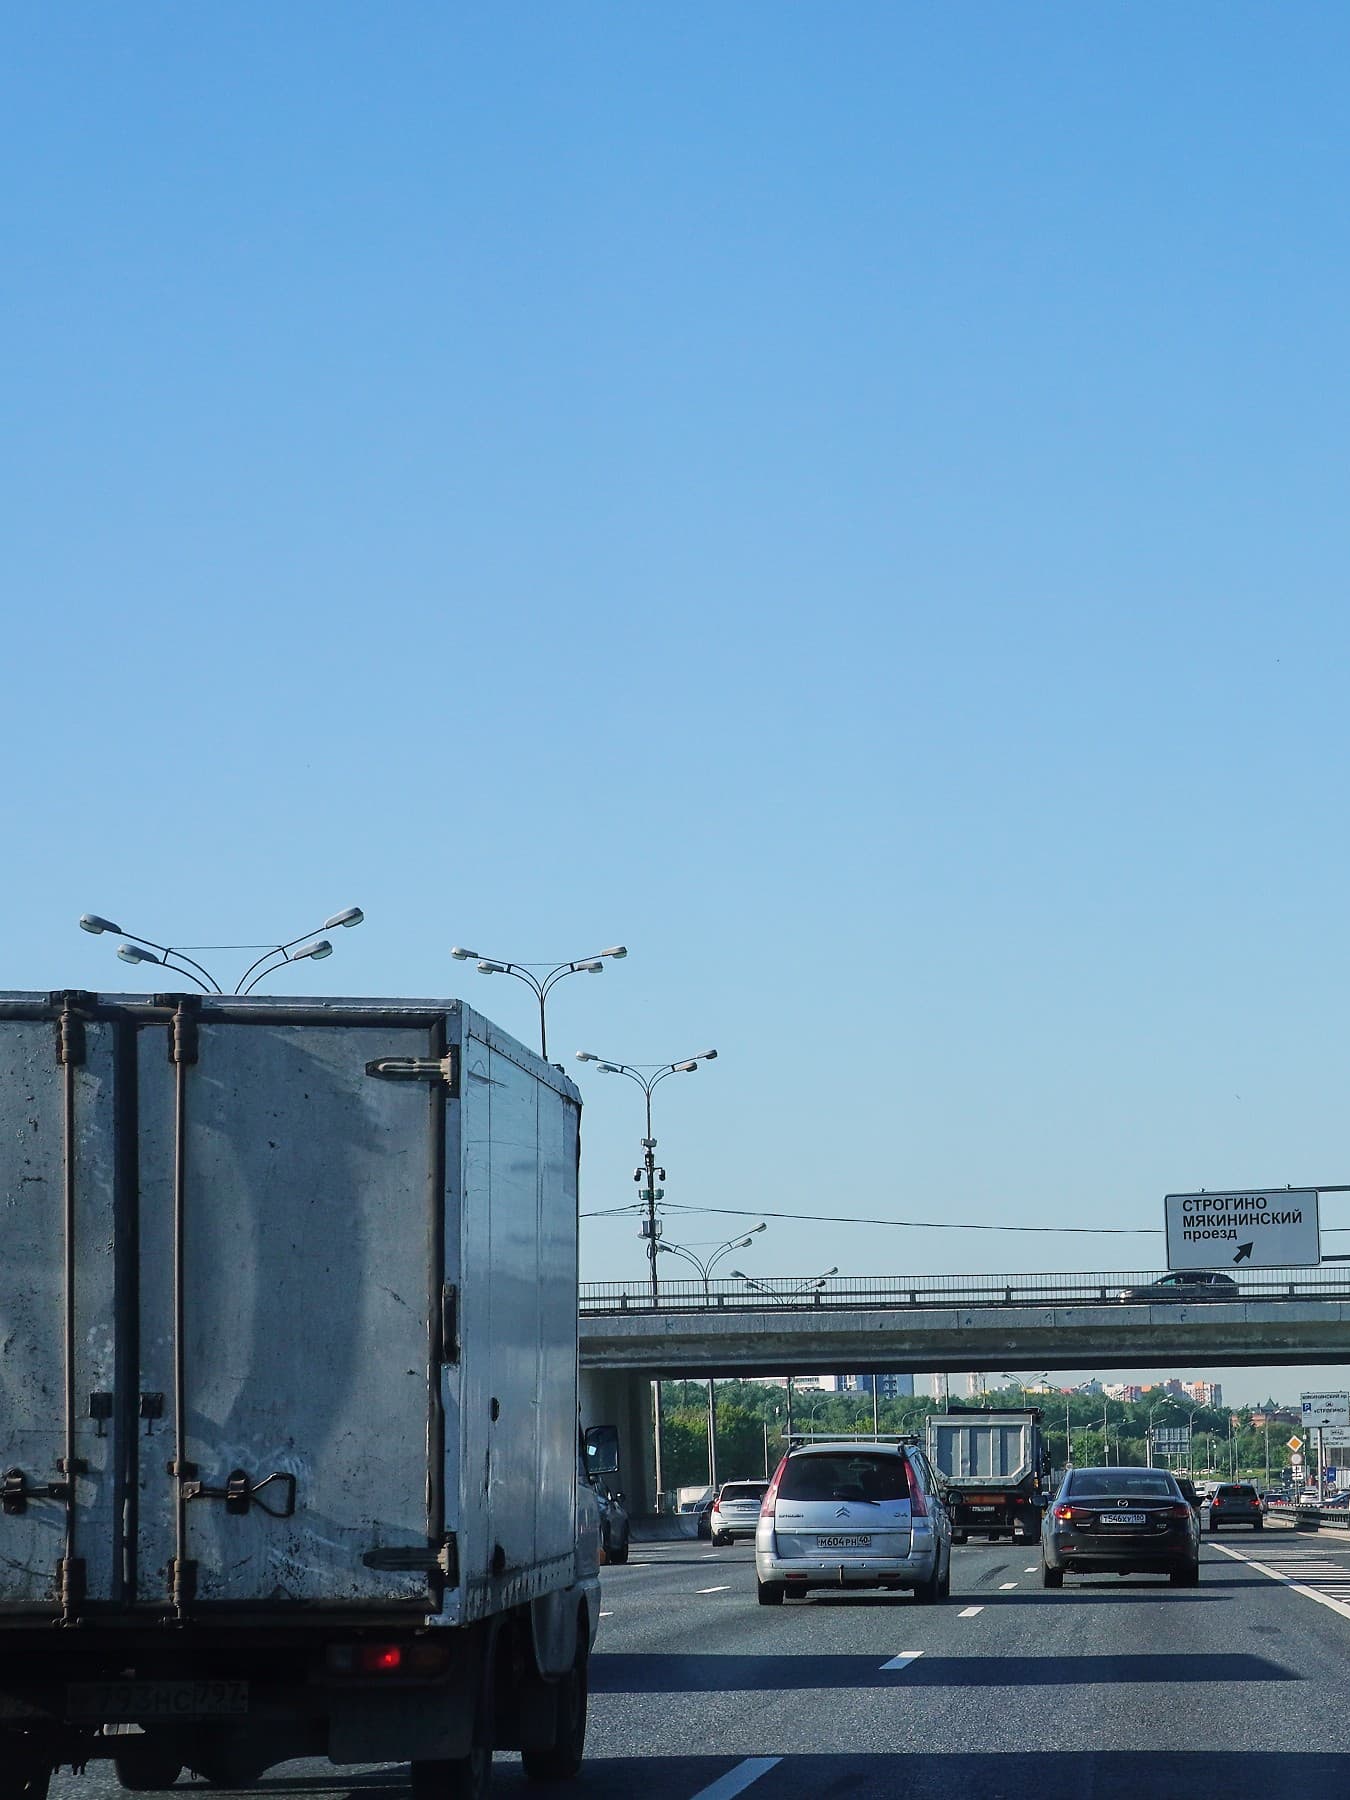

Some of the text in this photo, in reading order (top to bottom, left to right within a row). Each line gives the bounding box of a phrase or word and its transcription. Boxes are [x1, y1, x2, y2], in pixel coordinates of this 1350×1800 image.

[1182, 1197, 1268, 1212] СТРОГИНО
[1183, 1208, 1303, 1228] МЯКИНИНСКИЙ
[1183, 1228, 1238, 1243] проезд
